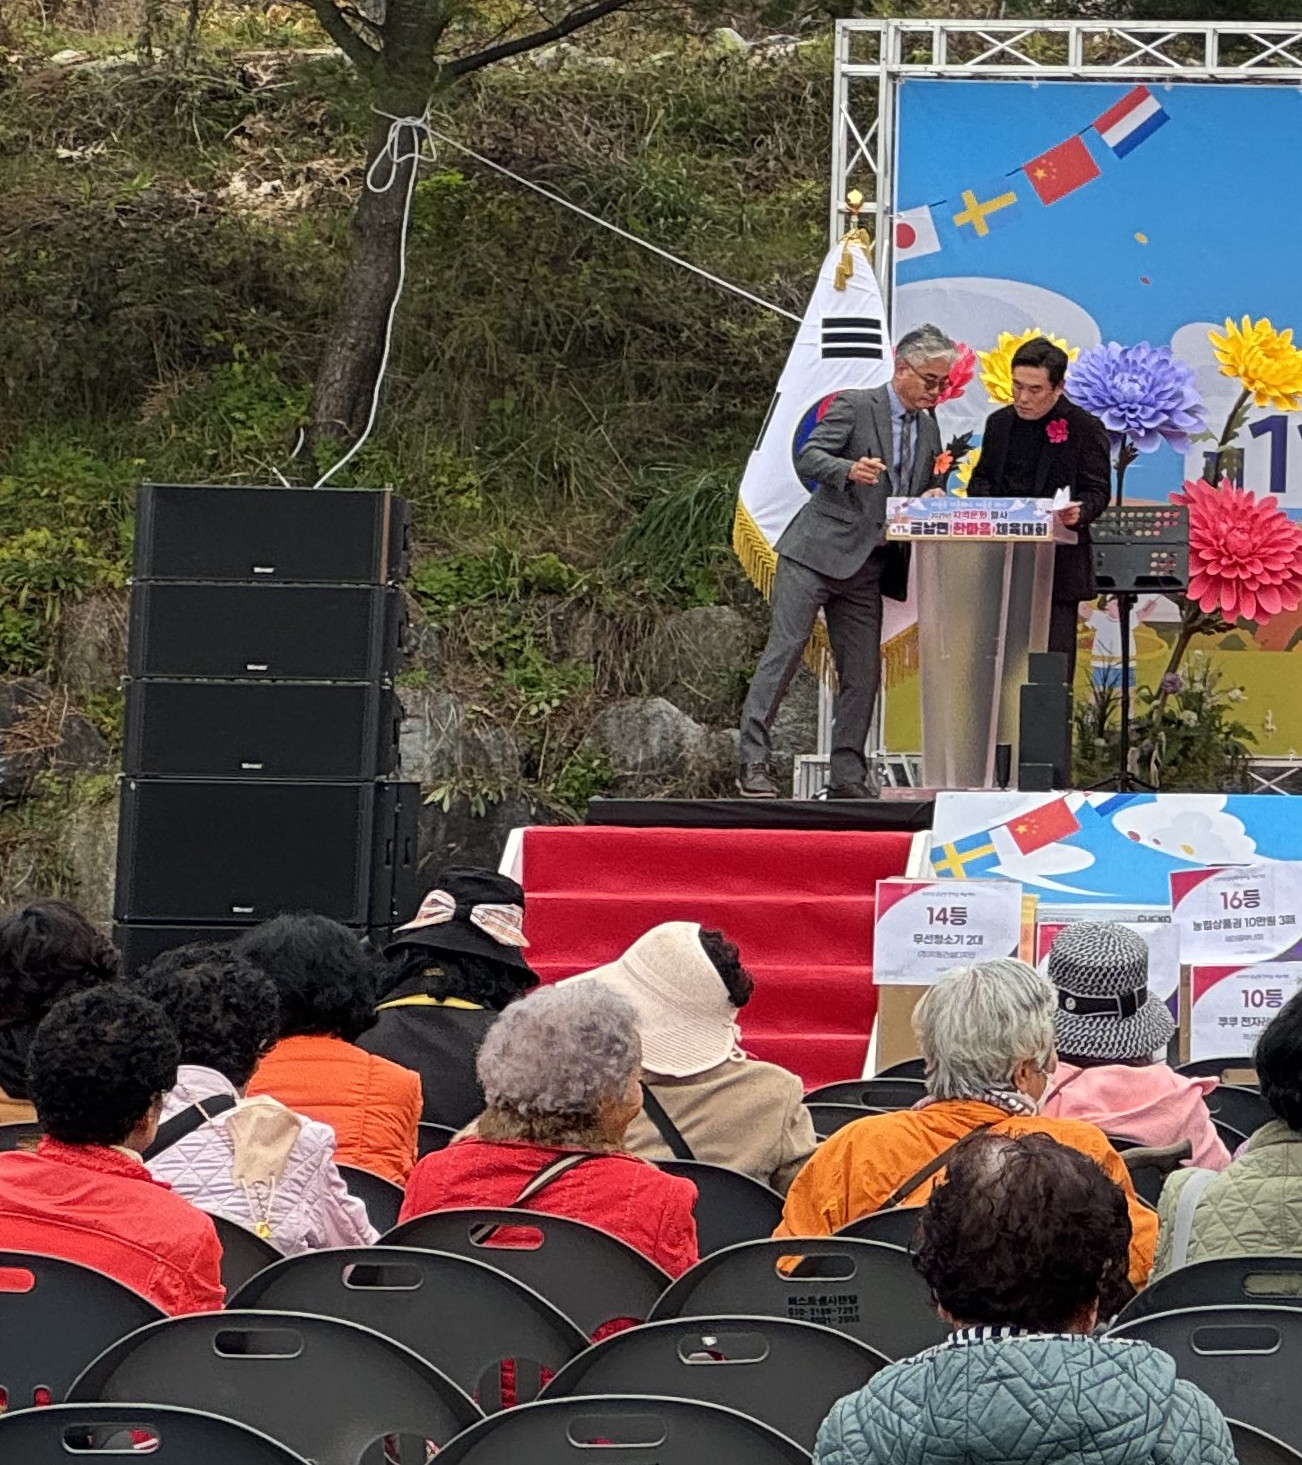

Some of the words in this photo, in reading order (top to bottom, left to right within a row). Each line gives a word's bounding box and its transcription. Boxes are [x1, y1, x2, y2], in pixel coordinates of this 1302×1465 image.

[1220, 889, 1261, 911] 16등
[926, 906, 968, 926] 14등
[913, 934, 965, 946] 무선청소기
[966, 934, 984, 945] 2대
[1241, 988, 1283, 1008] 10등
[1218, 1016, 1238, 1027] 쿠쿠
